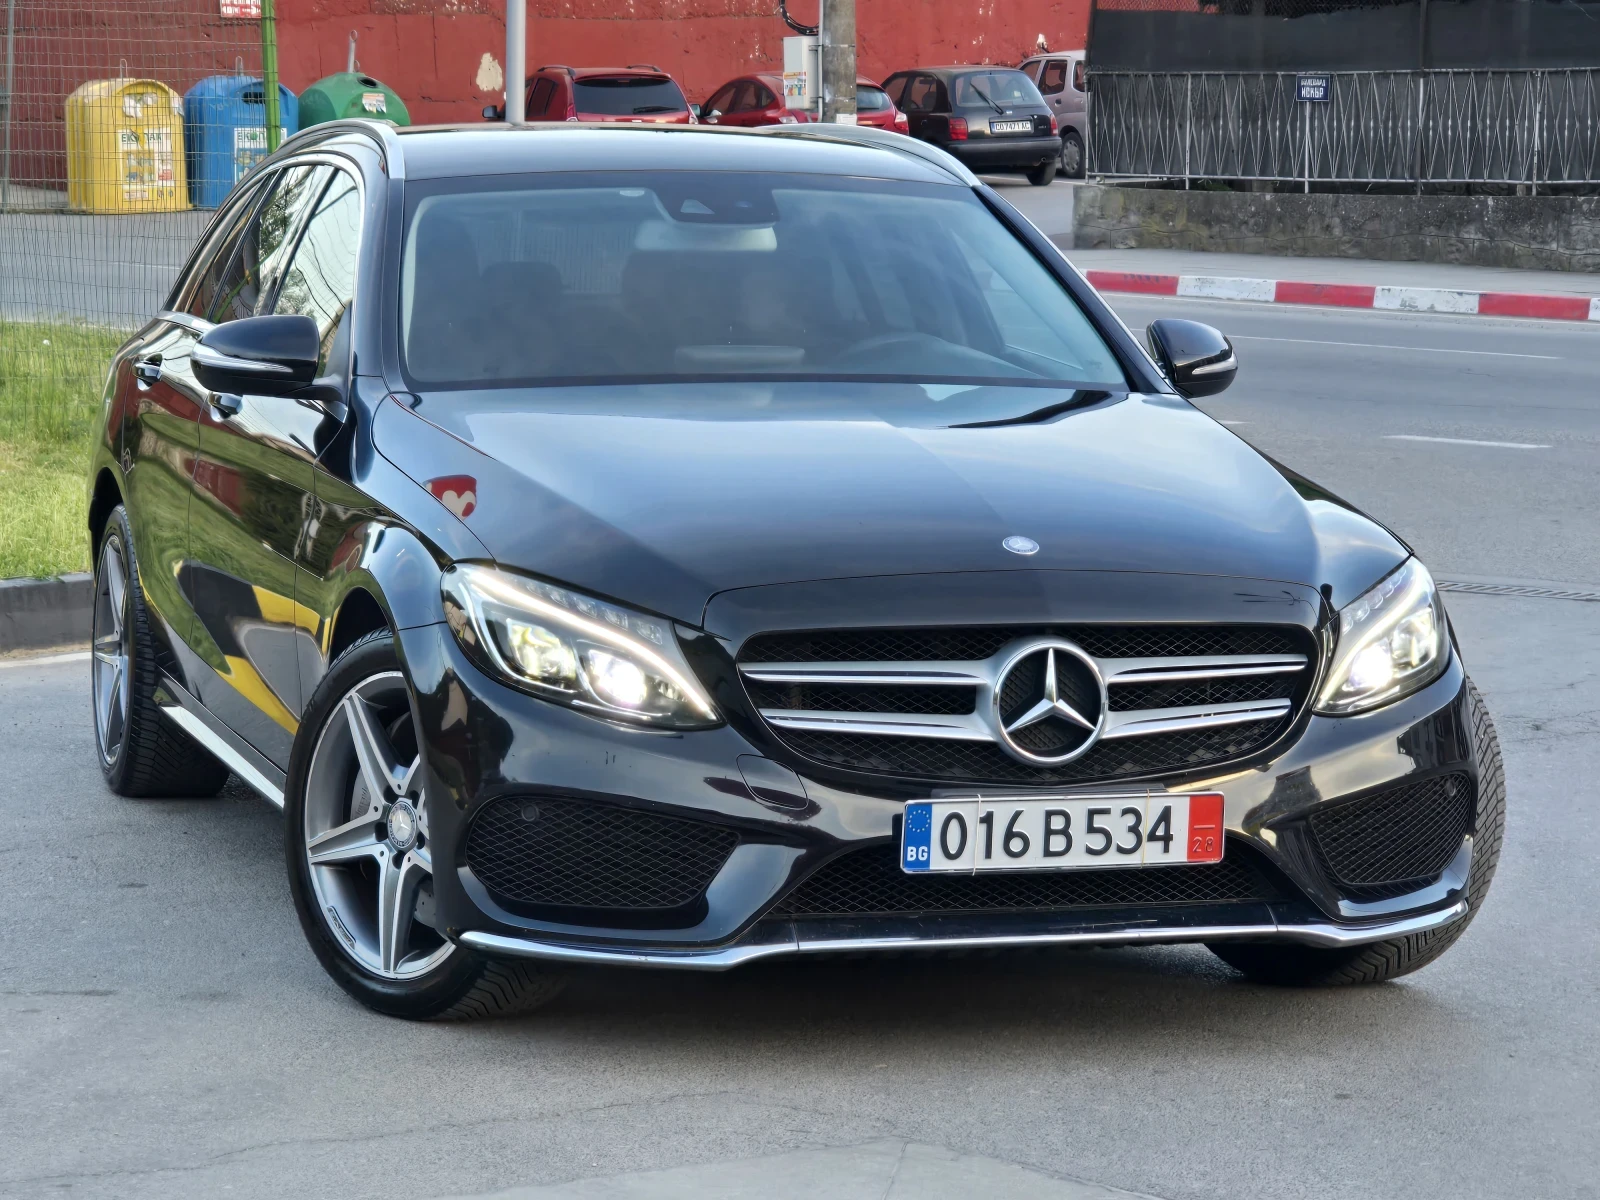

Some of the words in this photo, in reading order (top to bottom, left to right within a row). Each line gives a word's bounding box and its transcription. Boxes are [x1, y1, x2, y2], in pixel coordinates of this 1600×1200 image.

[1301, 87, 1324, 98] ИСКЪР
[1192, 836, 1215, 852] 28
[906, 845, 928, 862] BG
